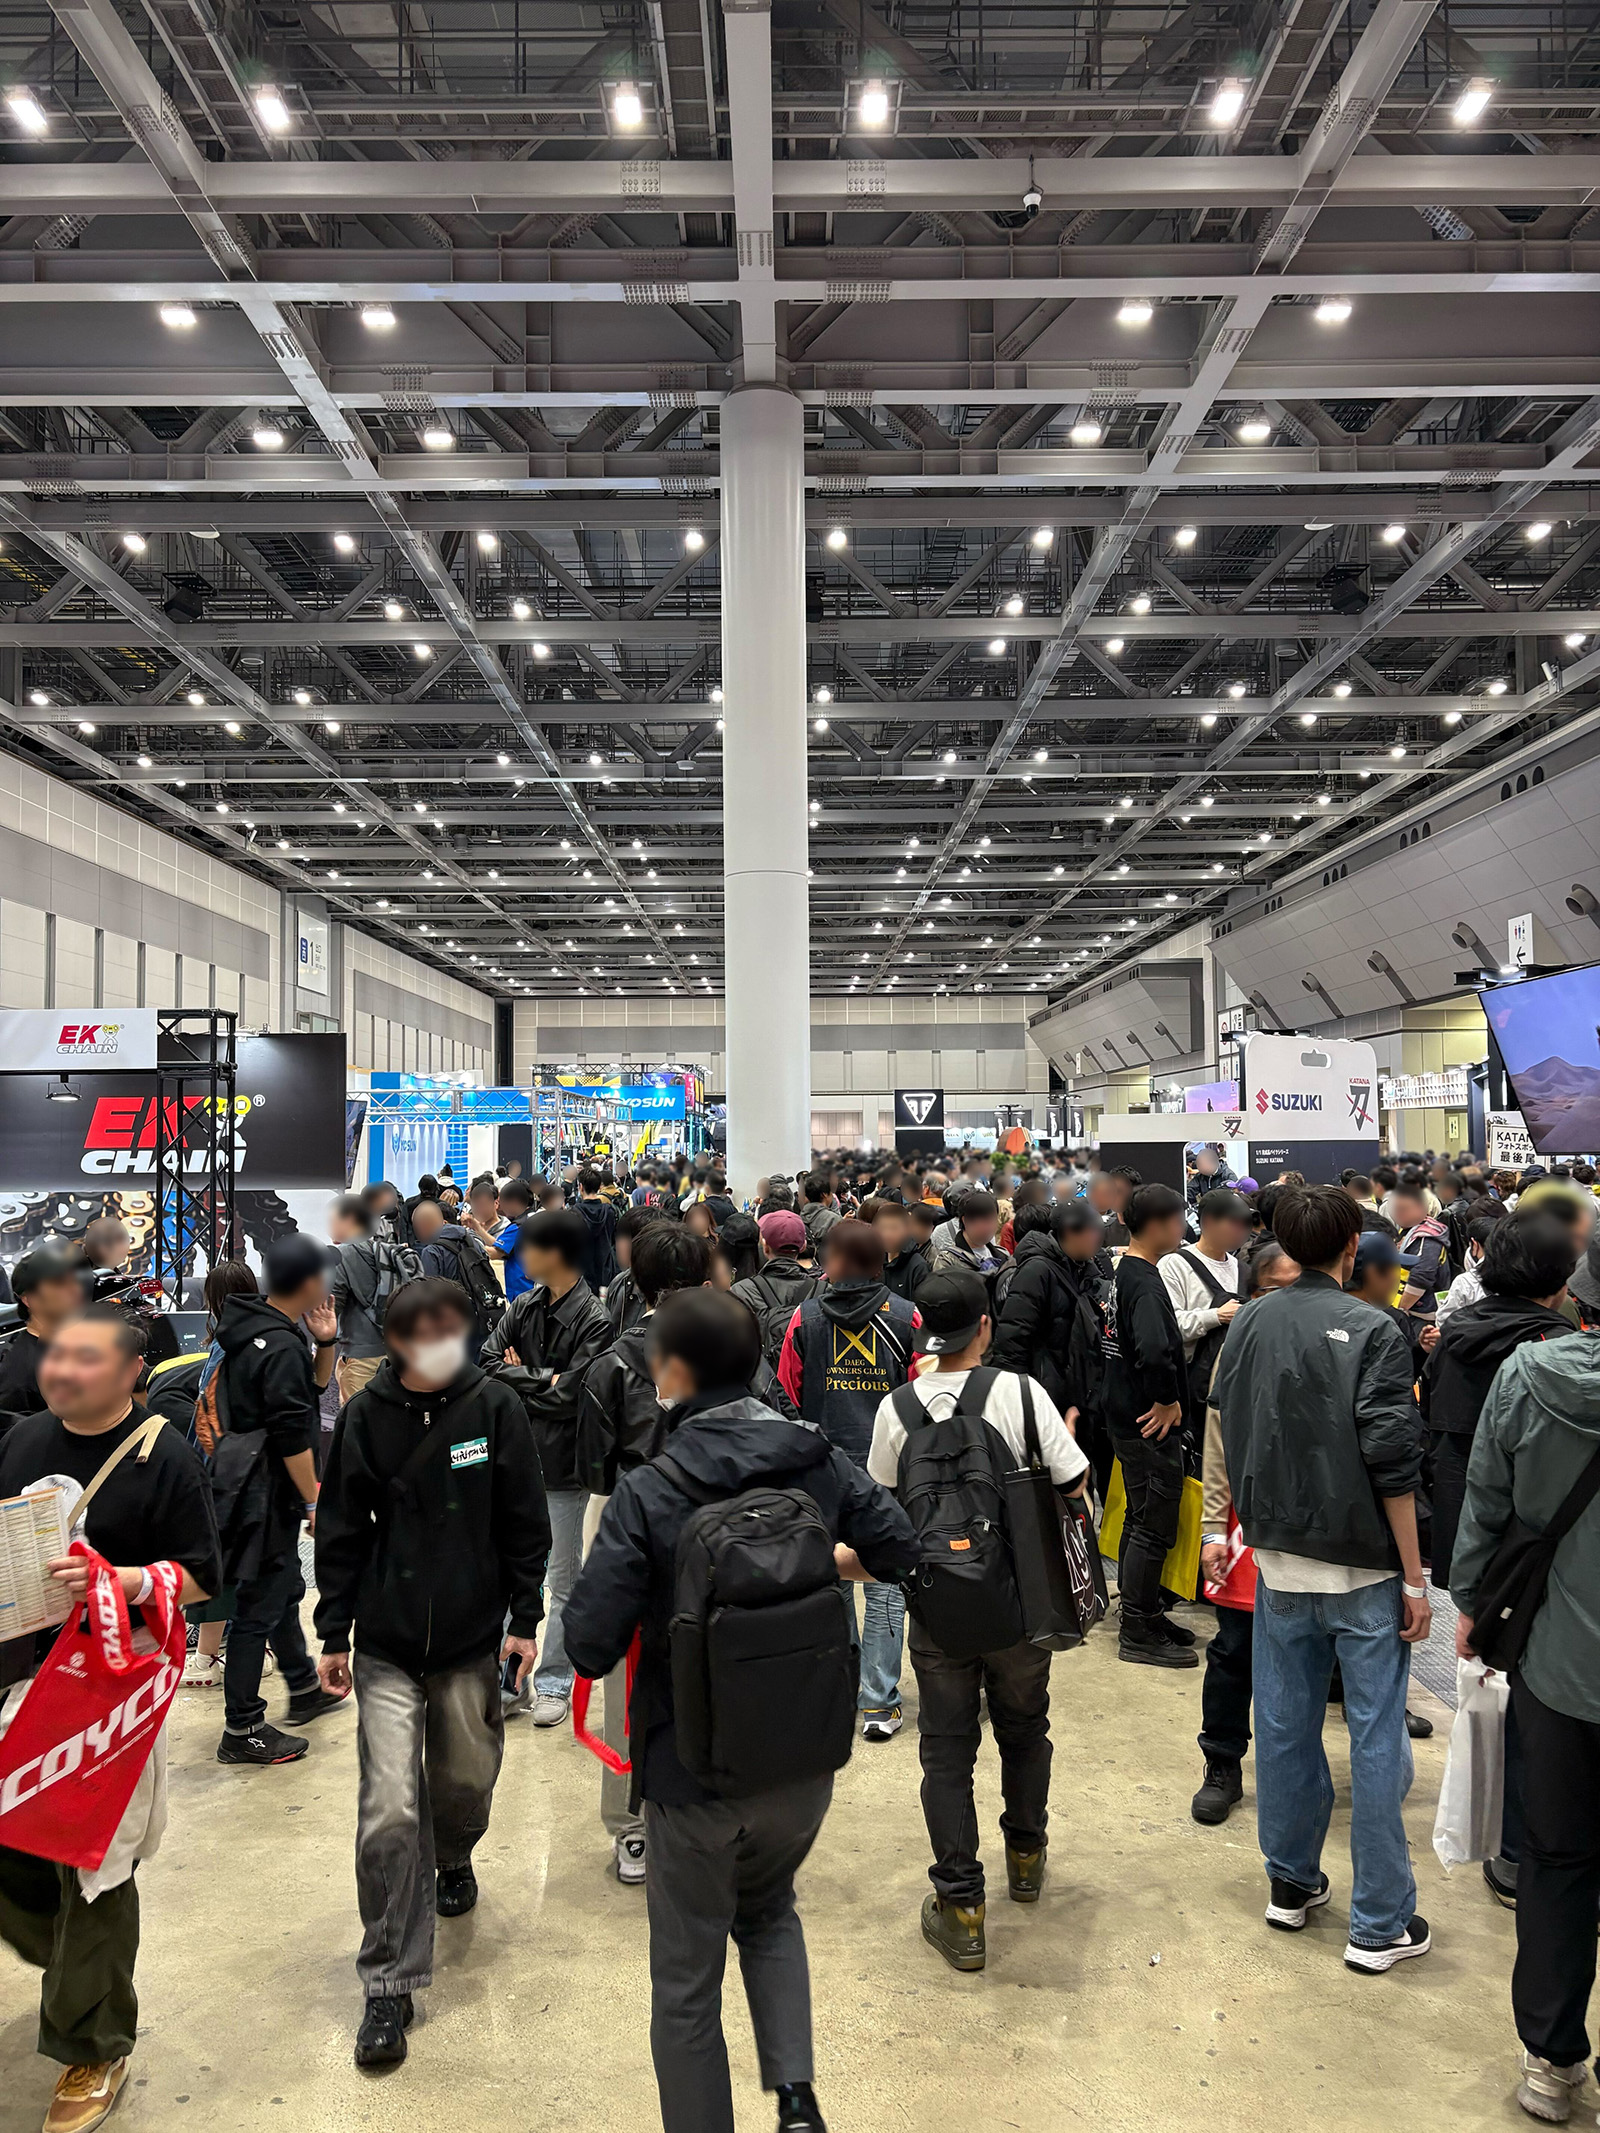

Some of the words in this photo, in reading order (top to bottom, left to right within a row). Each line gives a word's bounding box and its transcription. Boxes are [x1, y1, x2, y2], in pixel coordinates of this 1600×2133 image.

[58, 1025, 102, 1044] EK
[56, 1044, 118, 1054] CHAIN
[622, 1097, 675, 1108] YOSUN
[1271, 1093, 1323, 1111] SUZUKI
[83, 1096, 205, 1149] EK
[80, 1149, 247, 1175] CHAIN
[1500, 1151, 1536, 1164] 最後尾
[826, 1367, 862, 1375] OWNERS
[863, 1367, 887, 1375] CLUB
[826, 1377, 890, 1391] Precious
[0, 1664, 181, 1816] COYCO
